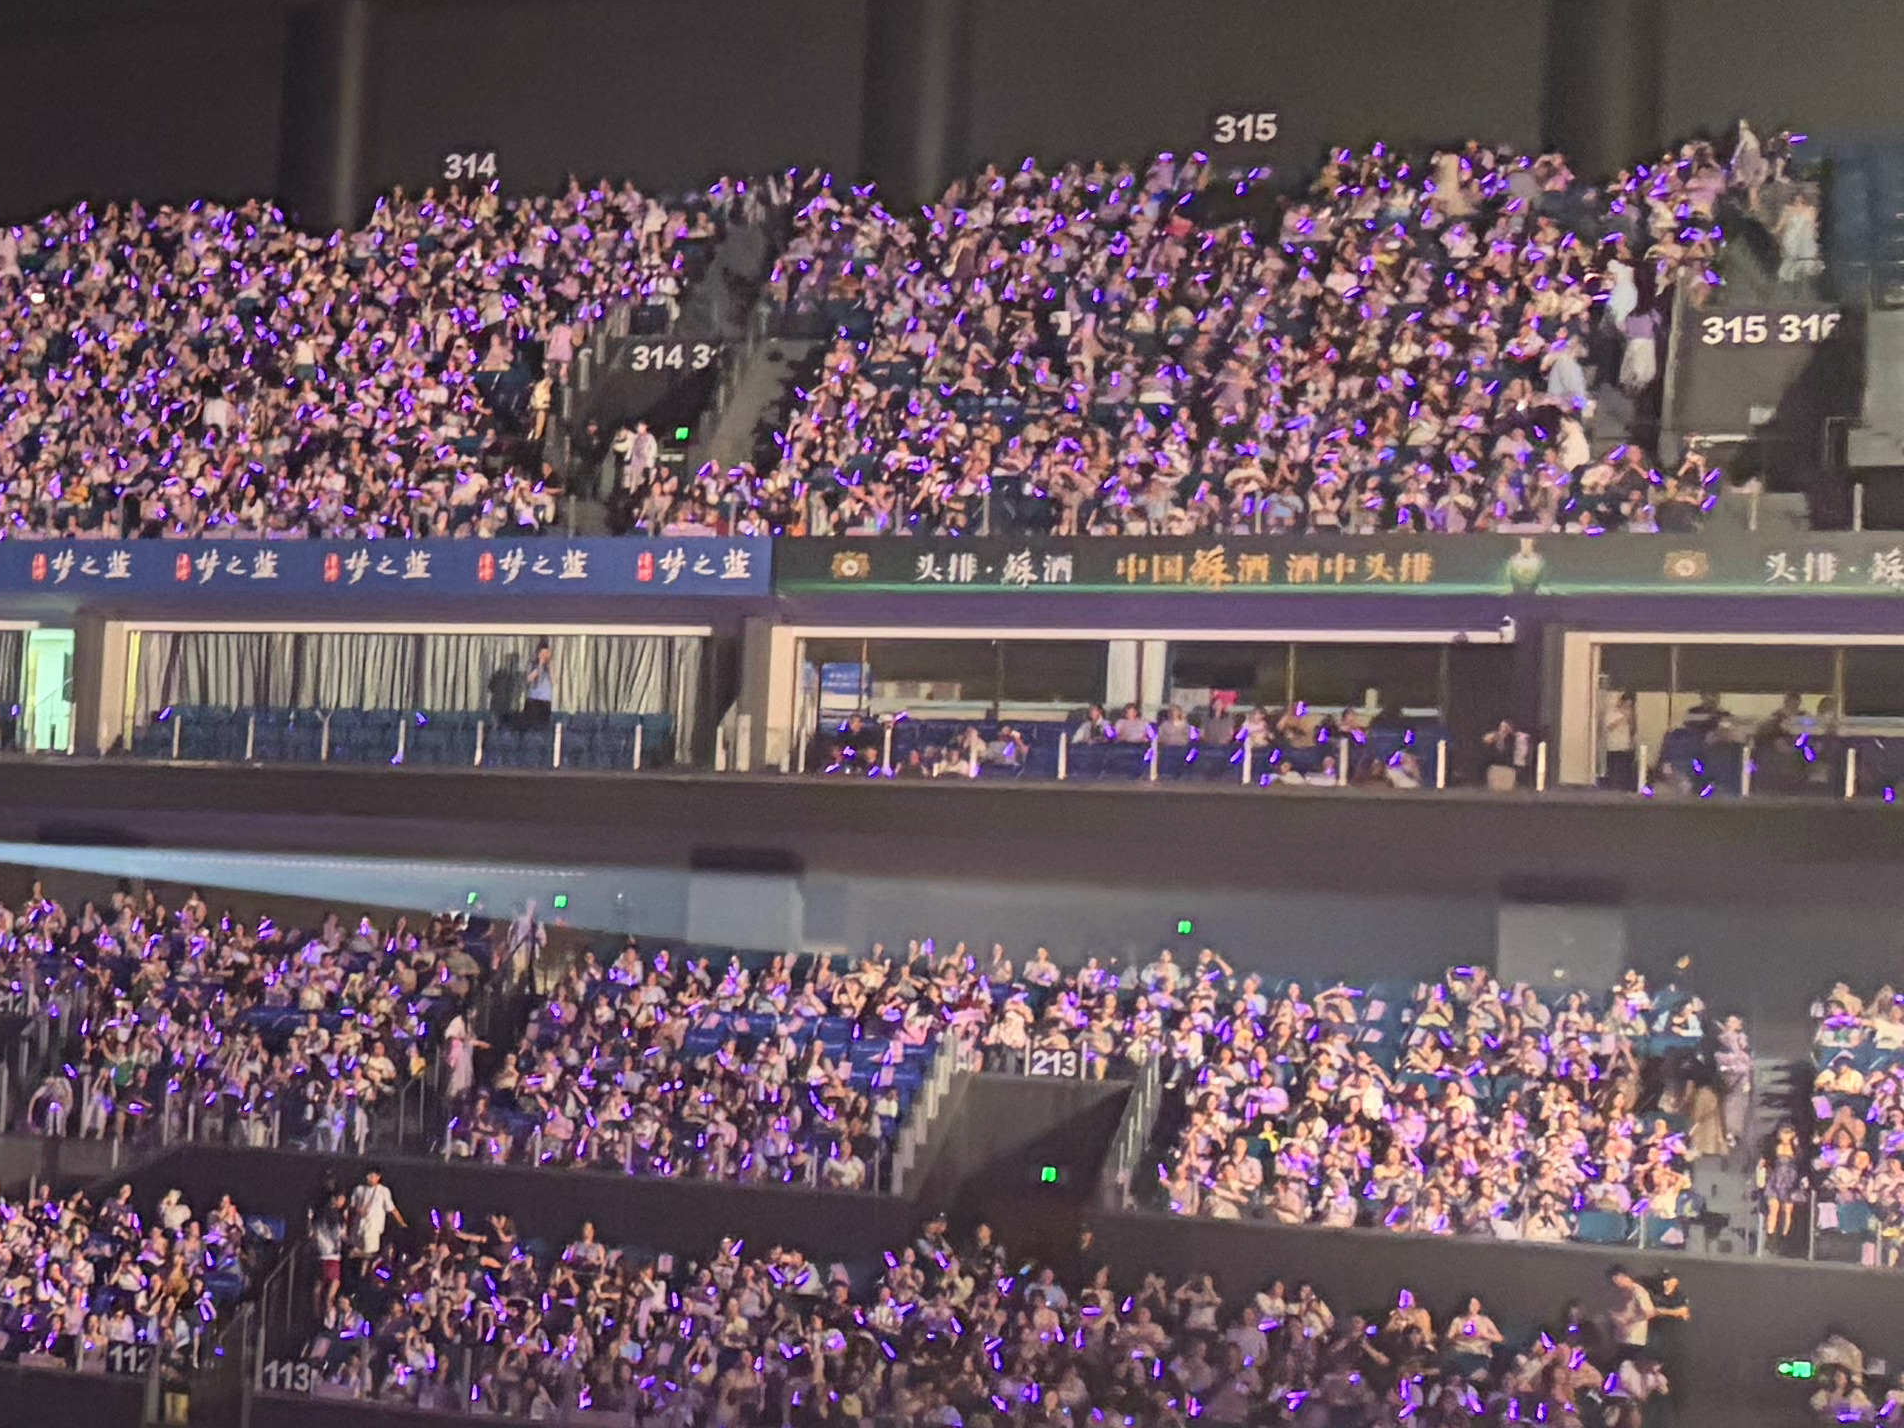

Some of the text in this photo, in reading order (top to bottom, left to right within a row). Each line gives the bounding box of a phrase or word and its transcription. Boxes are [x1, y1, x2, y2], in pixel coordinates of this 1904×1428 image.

[1214, 113, 1278, 143] 315
[445, 152, 498, 180] 314
[1699, 315, 1765, 344] 315
[632, 344, 684, 371] 314
[53, 550, 131, 583] 梦之蓝
[196, 550, 277, 582] 梦之蓝
[345, 550, 429, 585] 梦之蓝
[499, 549, 588, 584] 梦之蓝
[657, 547, 751, 585] 梦之蓝
[1287, 552, 1433, 583] 酒中头排
[1031, 1051, 1077, 1076] 213
[110, 1345, 153, 1373] 112
[264, 1360, 310, 1392] 113
